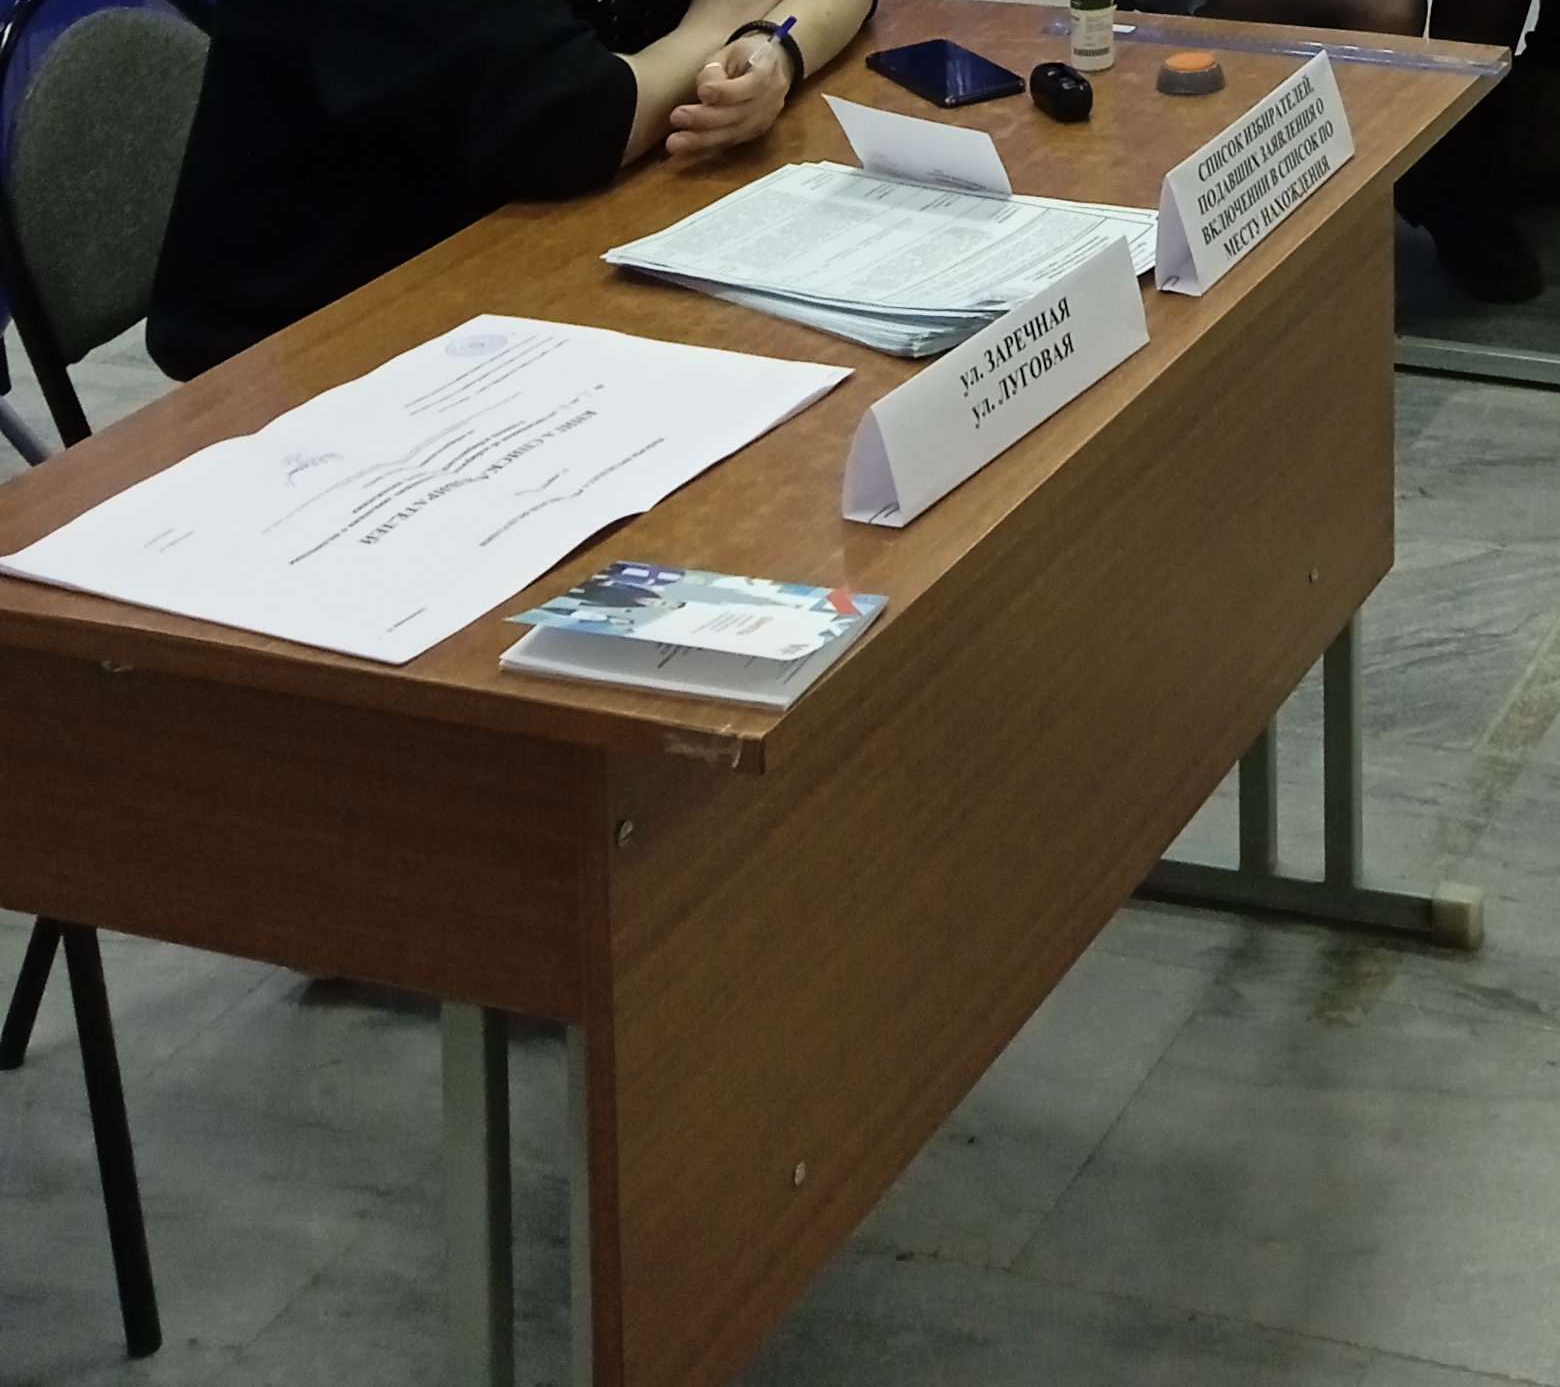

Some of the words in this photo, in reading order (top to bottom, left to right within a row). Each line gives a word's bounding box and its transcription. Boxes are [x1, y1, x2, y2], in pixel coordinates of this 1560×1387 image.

[1197, 132, 1244, 182] СПИСОК
[1242, 75, 1315, 145] ИЗБИРАТЕЛЕЙ,
[1197, 149, 1261, 216] ПОДАВШИХ
[1259, 104, 1318, 164] ЗАЯВЛЕНИЯ
[1315, 97, 1325, 116] О
[1201, 172, 1271, 246] ВКЛЮЧЕНИИ
[1269, 167, 1279, 188] В
[1277, 133, 1320, 179] СПИСОК
[1318, 119, 1335, 146] ПО
[1223, 215, 1261, 261] МЕСТУ
[1260, 154, 1331, 228] НАХОЖДЕНИЯ
[959, 365, 984, 398] ул.
[983, 296, 1071, 373] ЗАРЕЧНАЯ
[971, 397, 996, 429] ул.
[998, 332, 1075, 406] ЛУГОВАЯ
